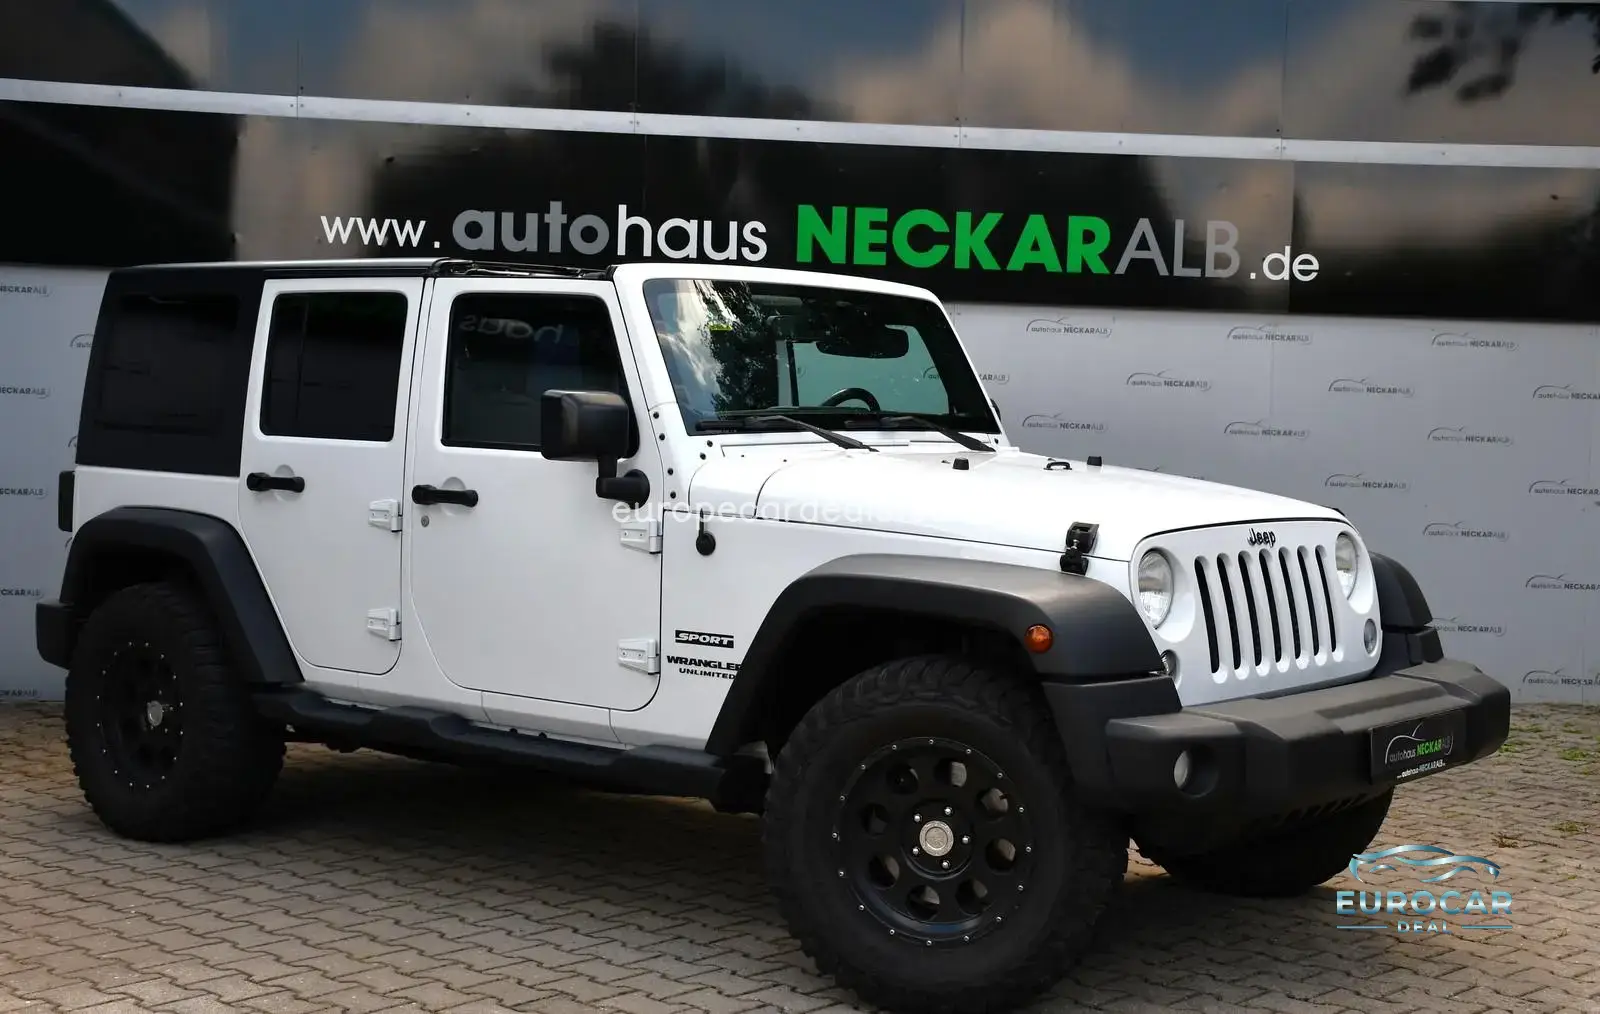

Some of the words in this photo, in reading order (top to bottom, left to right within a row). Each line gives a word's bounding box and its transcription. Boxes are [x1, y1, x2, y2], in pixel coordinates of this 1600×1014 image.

[452, 200, 768, 262] autohaus
[796, 204, 1241, 278] NECKARALB
[1247, 527, 1276, 548] Jeep
[676, 631, 733, 646] SPORT
[679, 667, 736, 680] UNLIMITED
